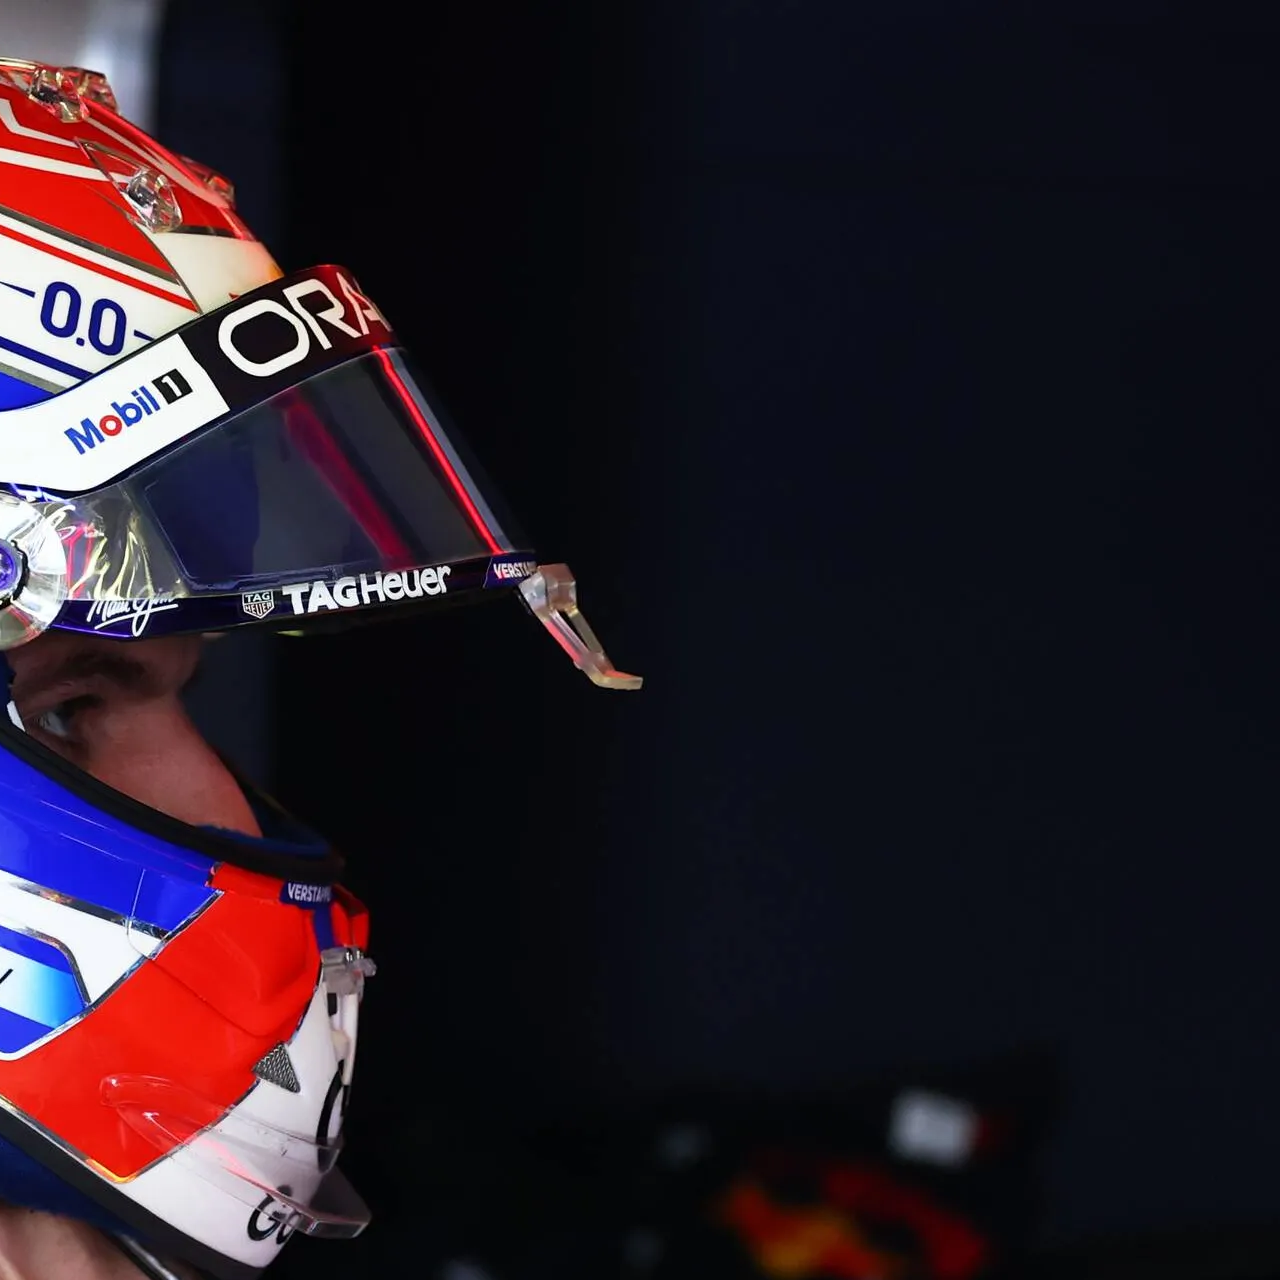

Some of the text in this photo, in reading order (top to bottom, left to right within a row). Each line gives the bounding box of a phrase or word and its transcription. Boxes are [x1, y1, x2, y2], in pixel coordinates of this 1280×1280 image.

[218, 271, 394, 377] ORA
[64, 385, 161, 455] Mobil
[245, 592, 271, 603] TAG
